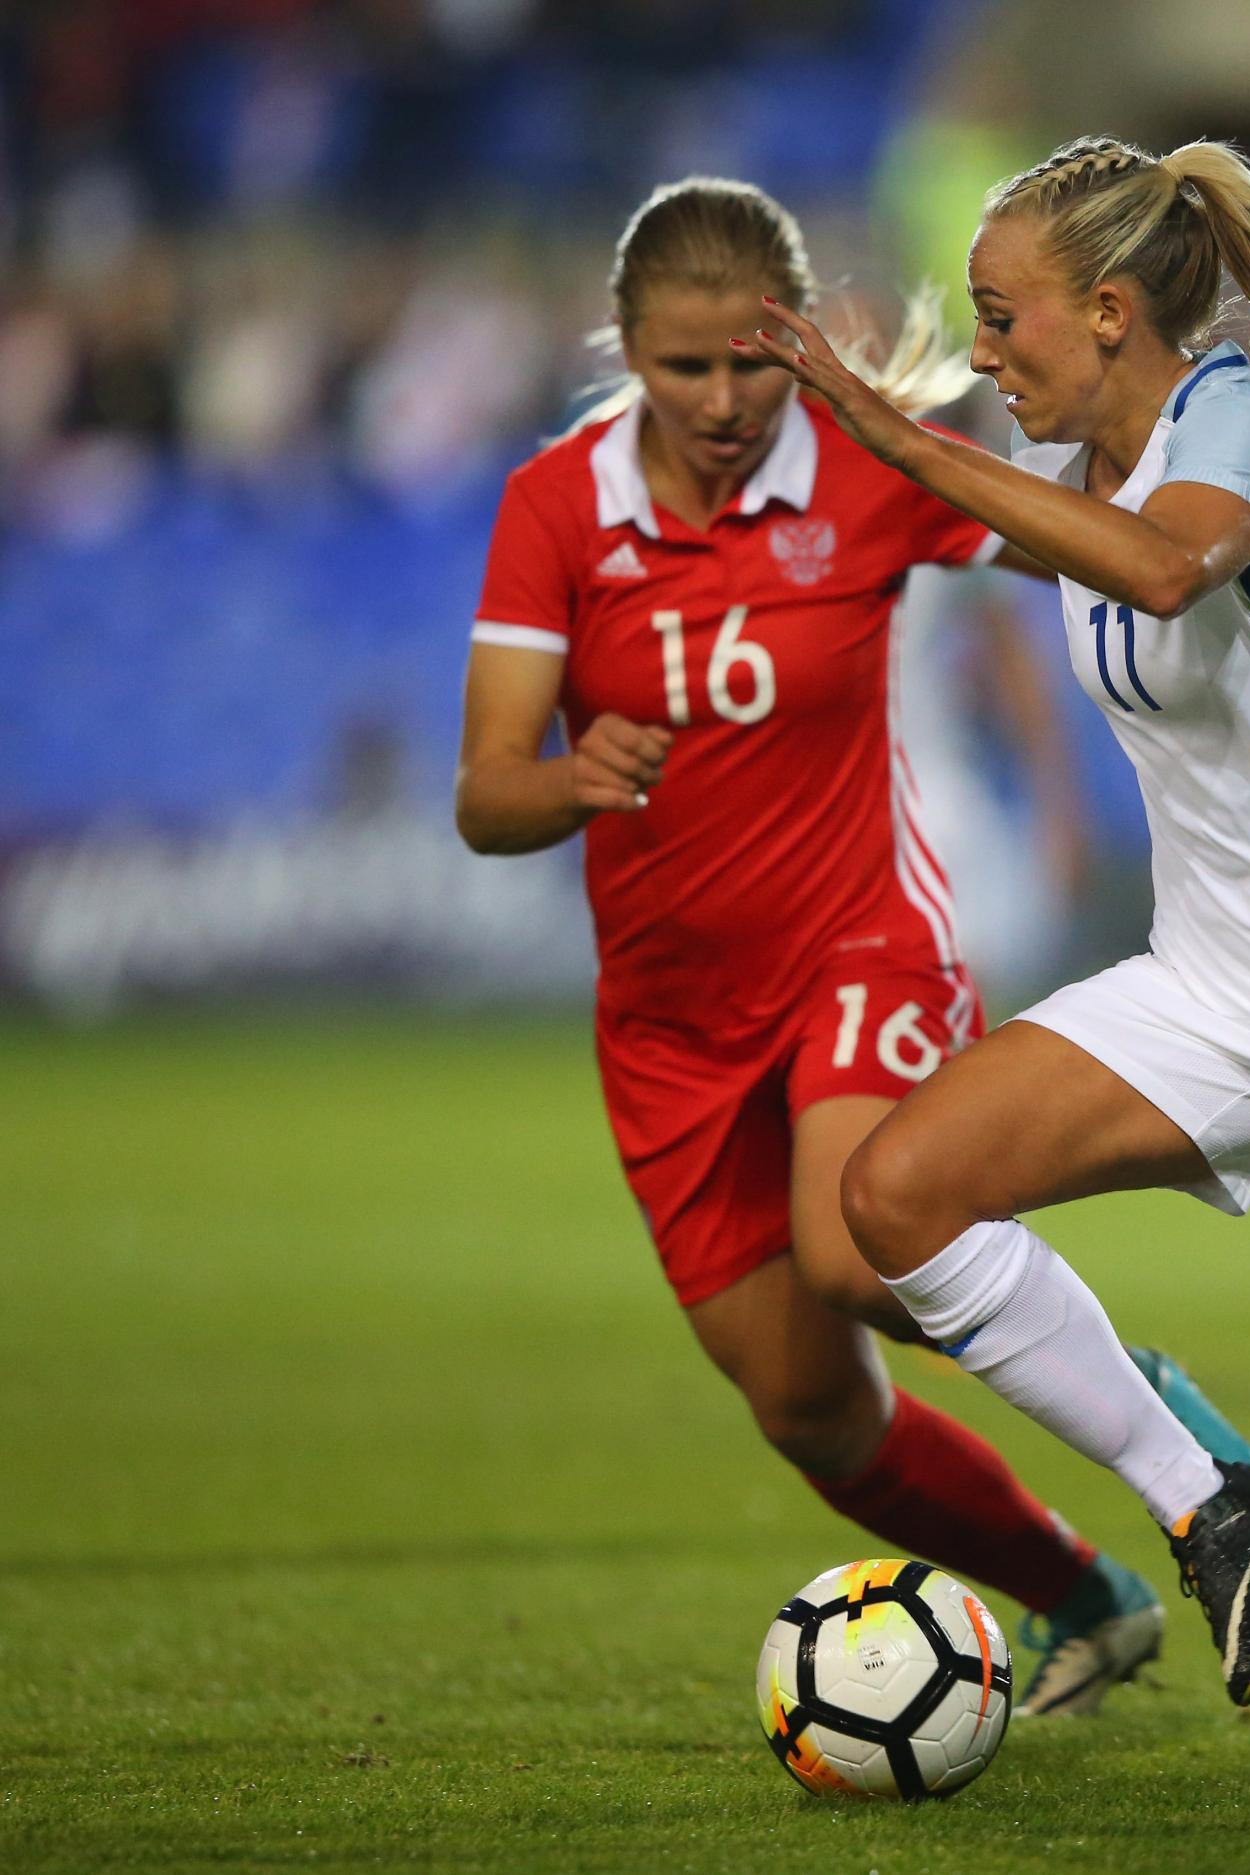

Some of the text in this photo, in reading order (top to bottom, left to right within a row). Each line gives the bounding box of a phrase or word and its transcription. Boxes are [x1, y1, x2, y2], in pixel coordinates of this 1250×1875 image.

[651, 605, 776, 725] 16
[1089, 600, 1163, 712] 11
[832, 982, 943, 1082] 16
